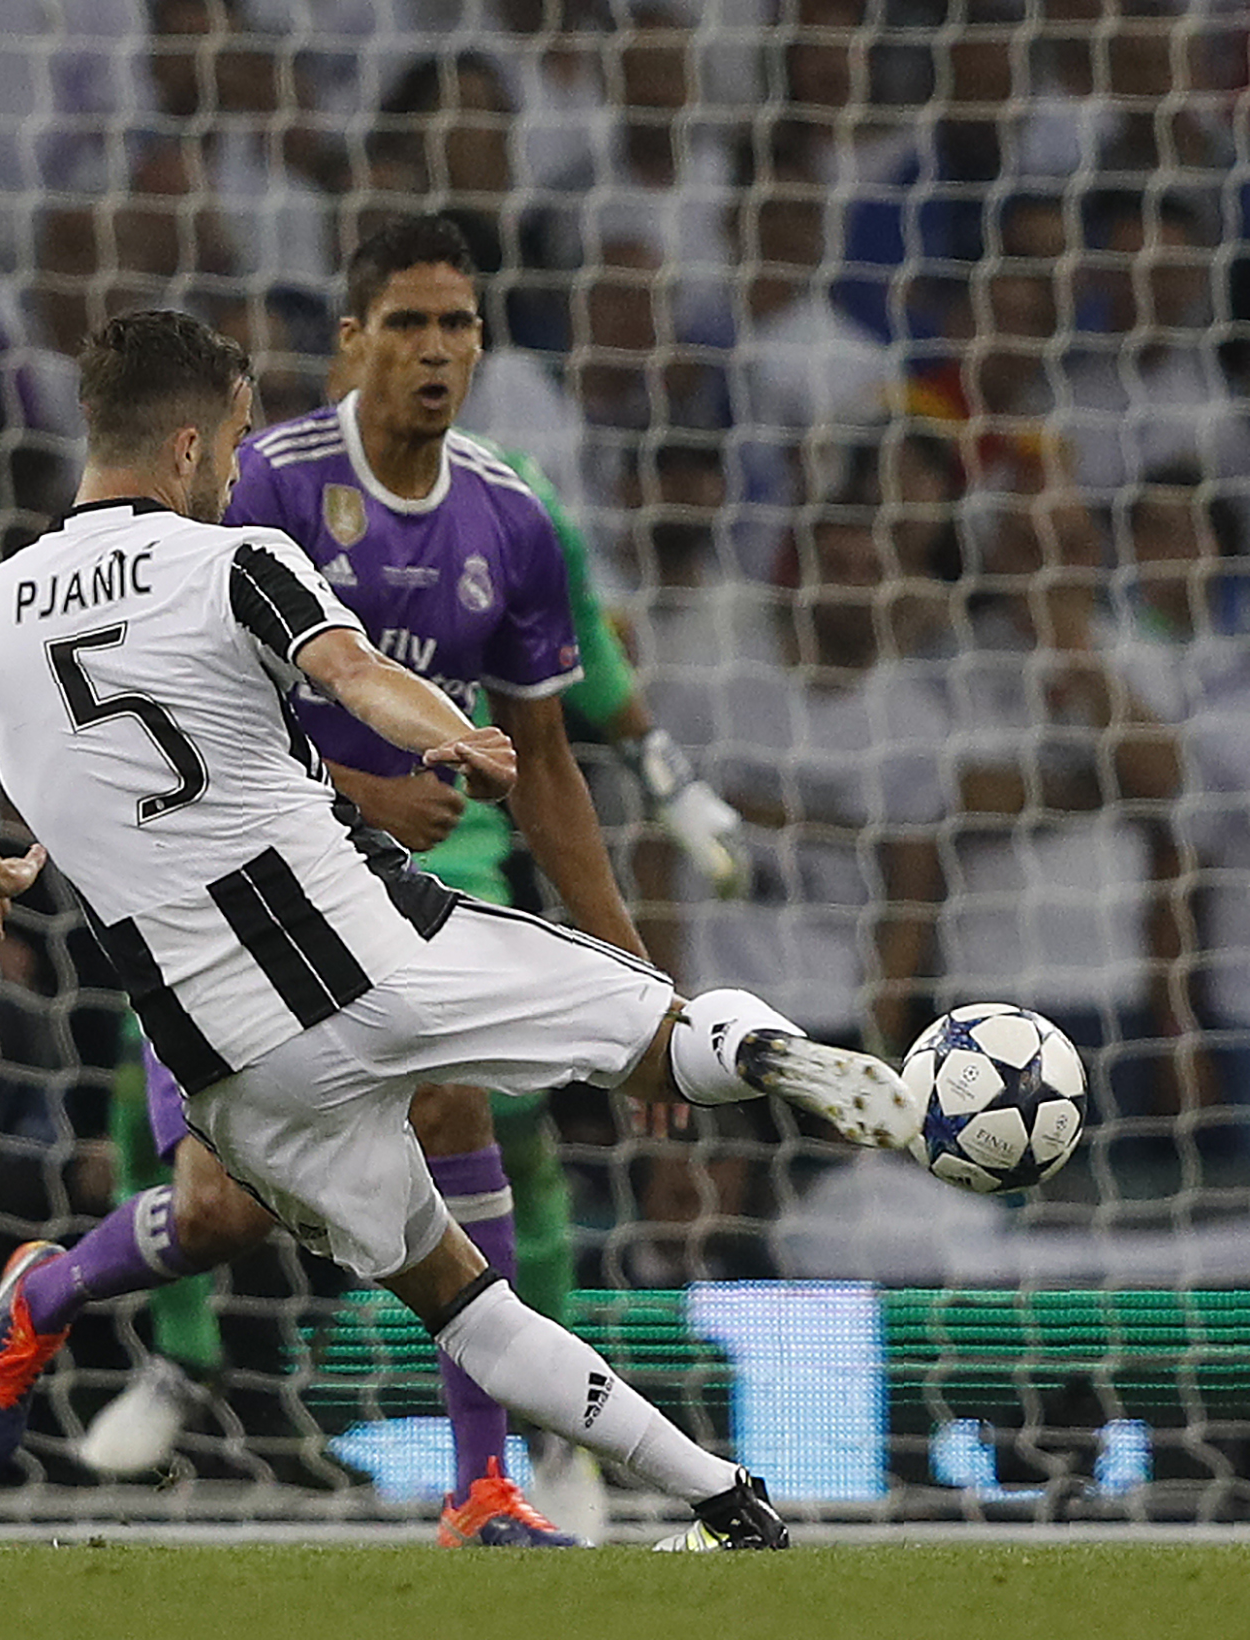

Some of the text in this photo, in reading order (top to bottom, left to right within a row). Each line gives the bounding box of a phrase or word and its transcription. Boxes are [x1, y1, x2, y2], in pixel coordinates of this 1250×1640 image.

[380, 628, 437, 671] Fly
[44, 621, 209, 826] 5
[976, 1128, 1014, 1155] FINAL
